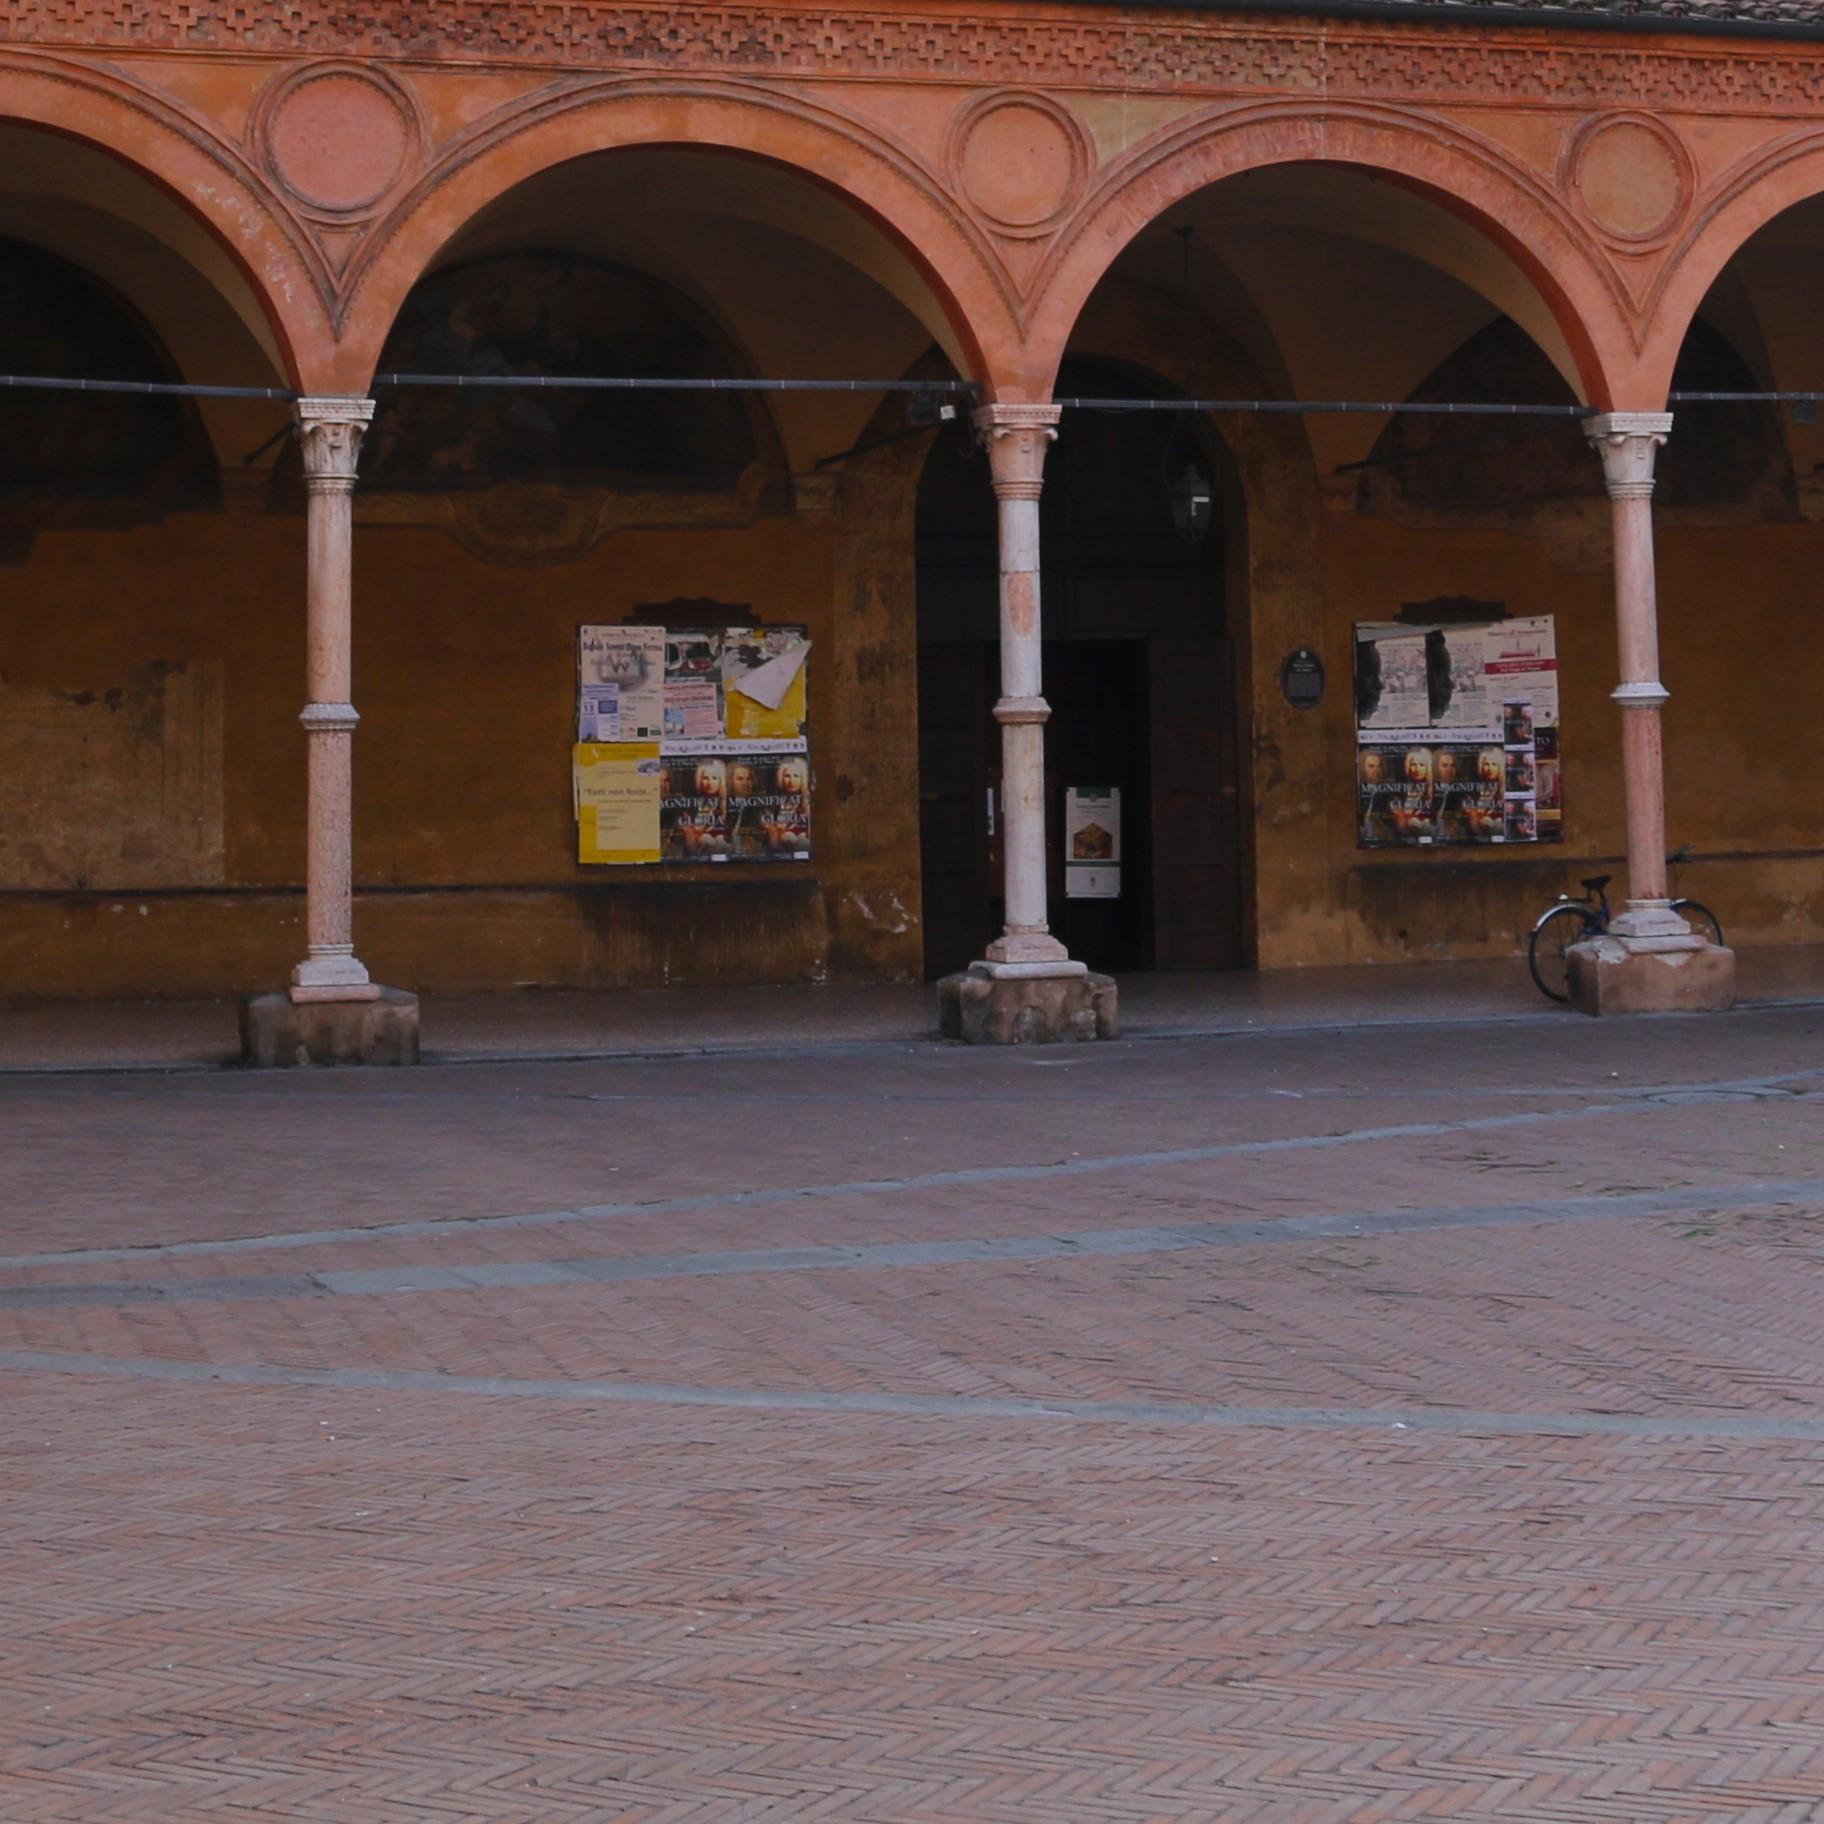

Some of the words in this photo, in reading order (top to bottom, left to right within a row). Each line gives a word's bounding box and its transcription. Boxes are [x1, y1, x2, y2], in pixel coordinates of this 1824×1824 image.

[728, 794, 802, 807] MAGNIFICAT
[678, 813, 725, 826] GLORIA
[760, 812, 806, 825] GLORIA
